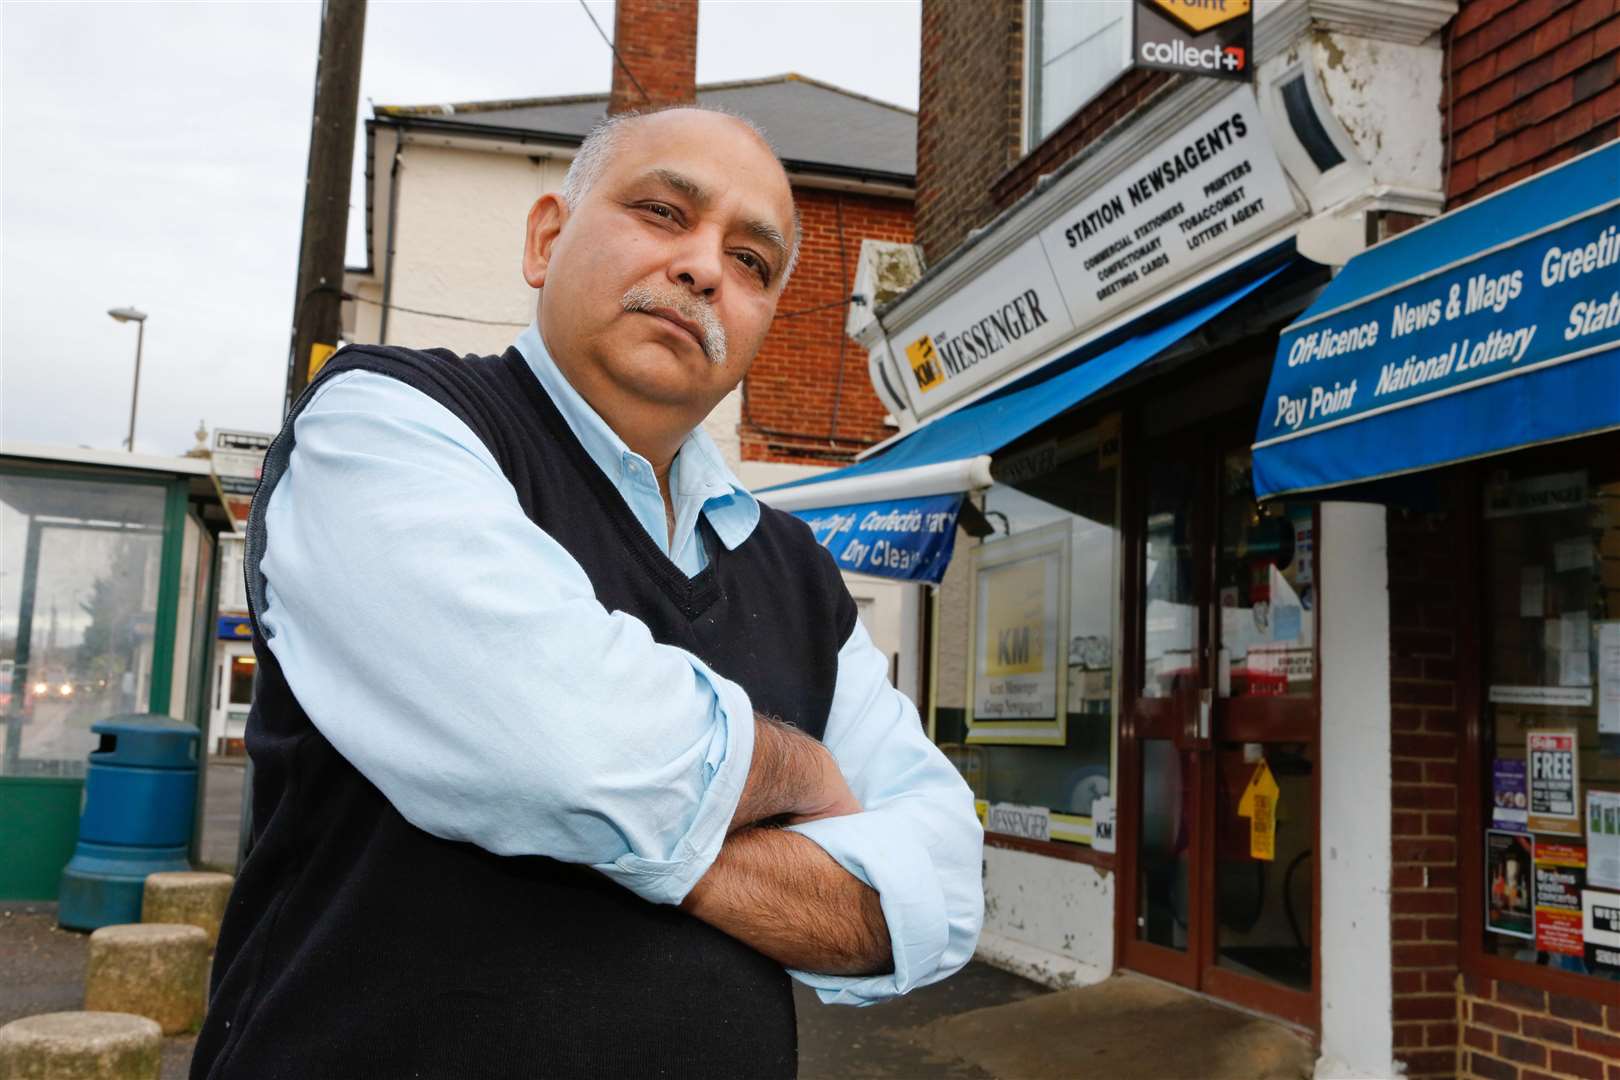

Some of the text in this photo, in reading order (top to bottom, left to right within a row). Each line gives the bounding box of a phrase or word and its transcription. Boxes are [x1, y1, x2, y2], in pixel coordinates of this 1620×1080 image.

[1171, 0, 1227, 11] oint
[1065, 113, 1248, 248] STATION NEWSAGENTS
[1083, 160, 1252, 271] COMMERCIAL STATIONERS PRINTERS
[1096, 198, 1265, 301] GREETINGS CARDS LOTTERY AGENT
[1097, 186, 1246, 281] CONFECTIONARY TOBACCONIST
[939, 288, 1048, 379] MESSENGER
[1287, 320, 1379, 368] Off-licence
[1390, 298, 1441, 339] News
[1445, 283, 1461, 321] &
[1464, 269, 1523, 315] Mags
[1274, 396, 1308, 430] Pay
[1309, 378, 1358, 420] Point
[1373, 341, 1457, 397] National
[1455, 324, 1538, 374] Lottery
[998, 624, 1029, 667] KM
[1532, 751, 1571, 780] FREE
[1096, 822, 1112, 839] KM
